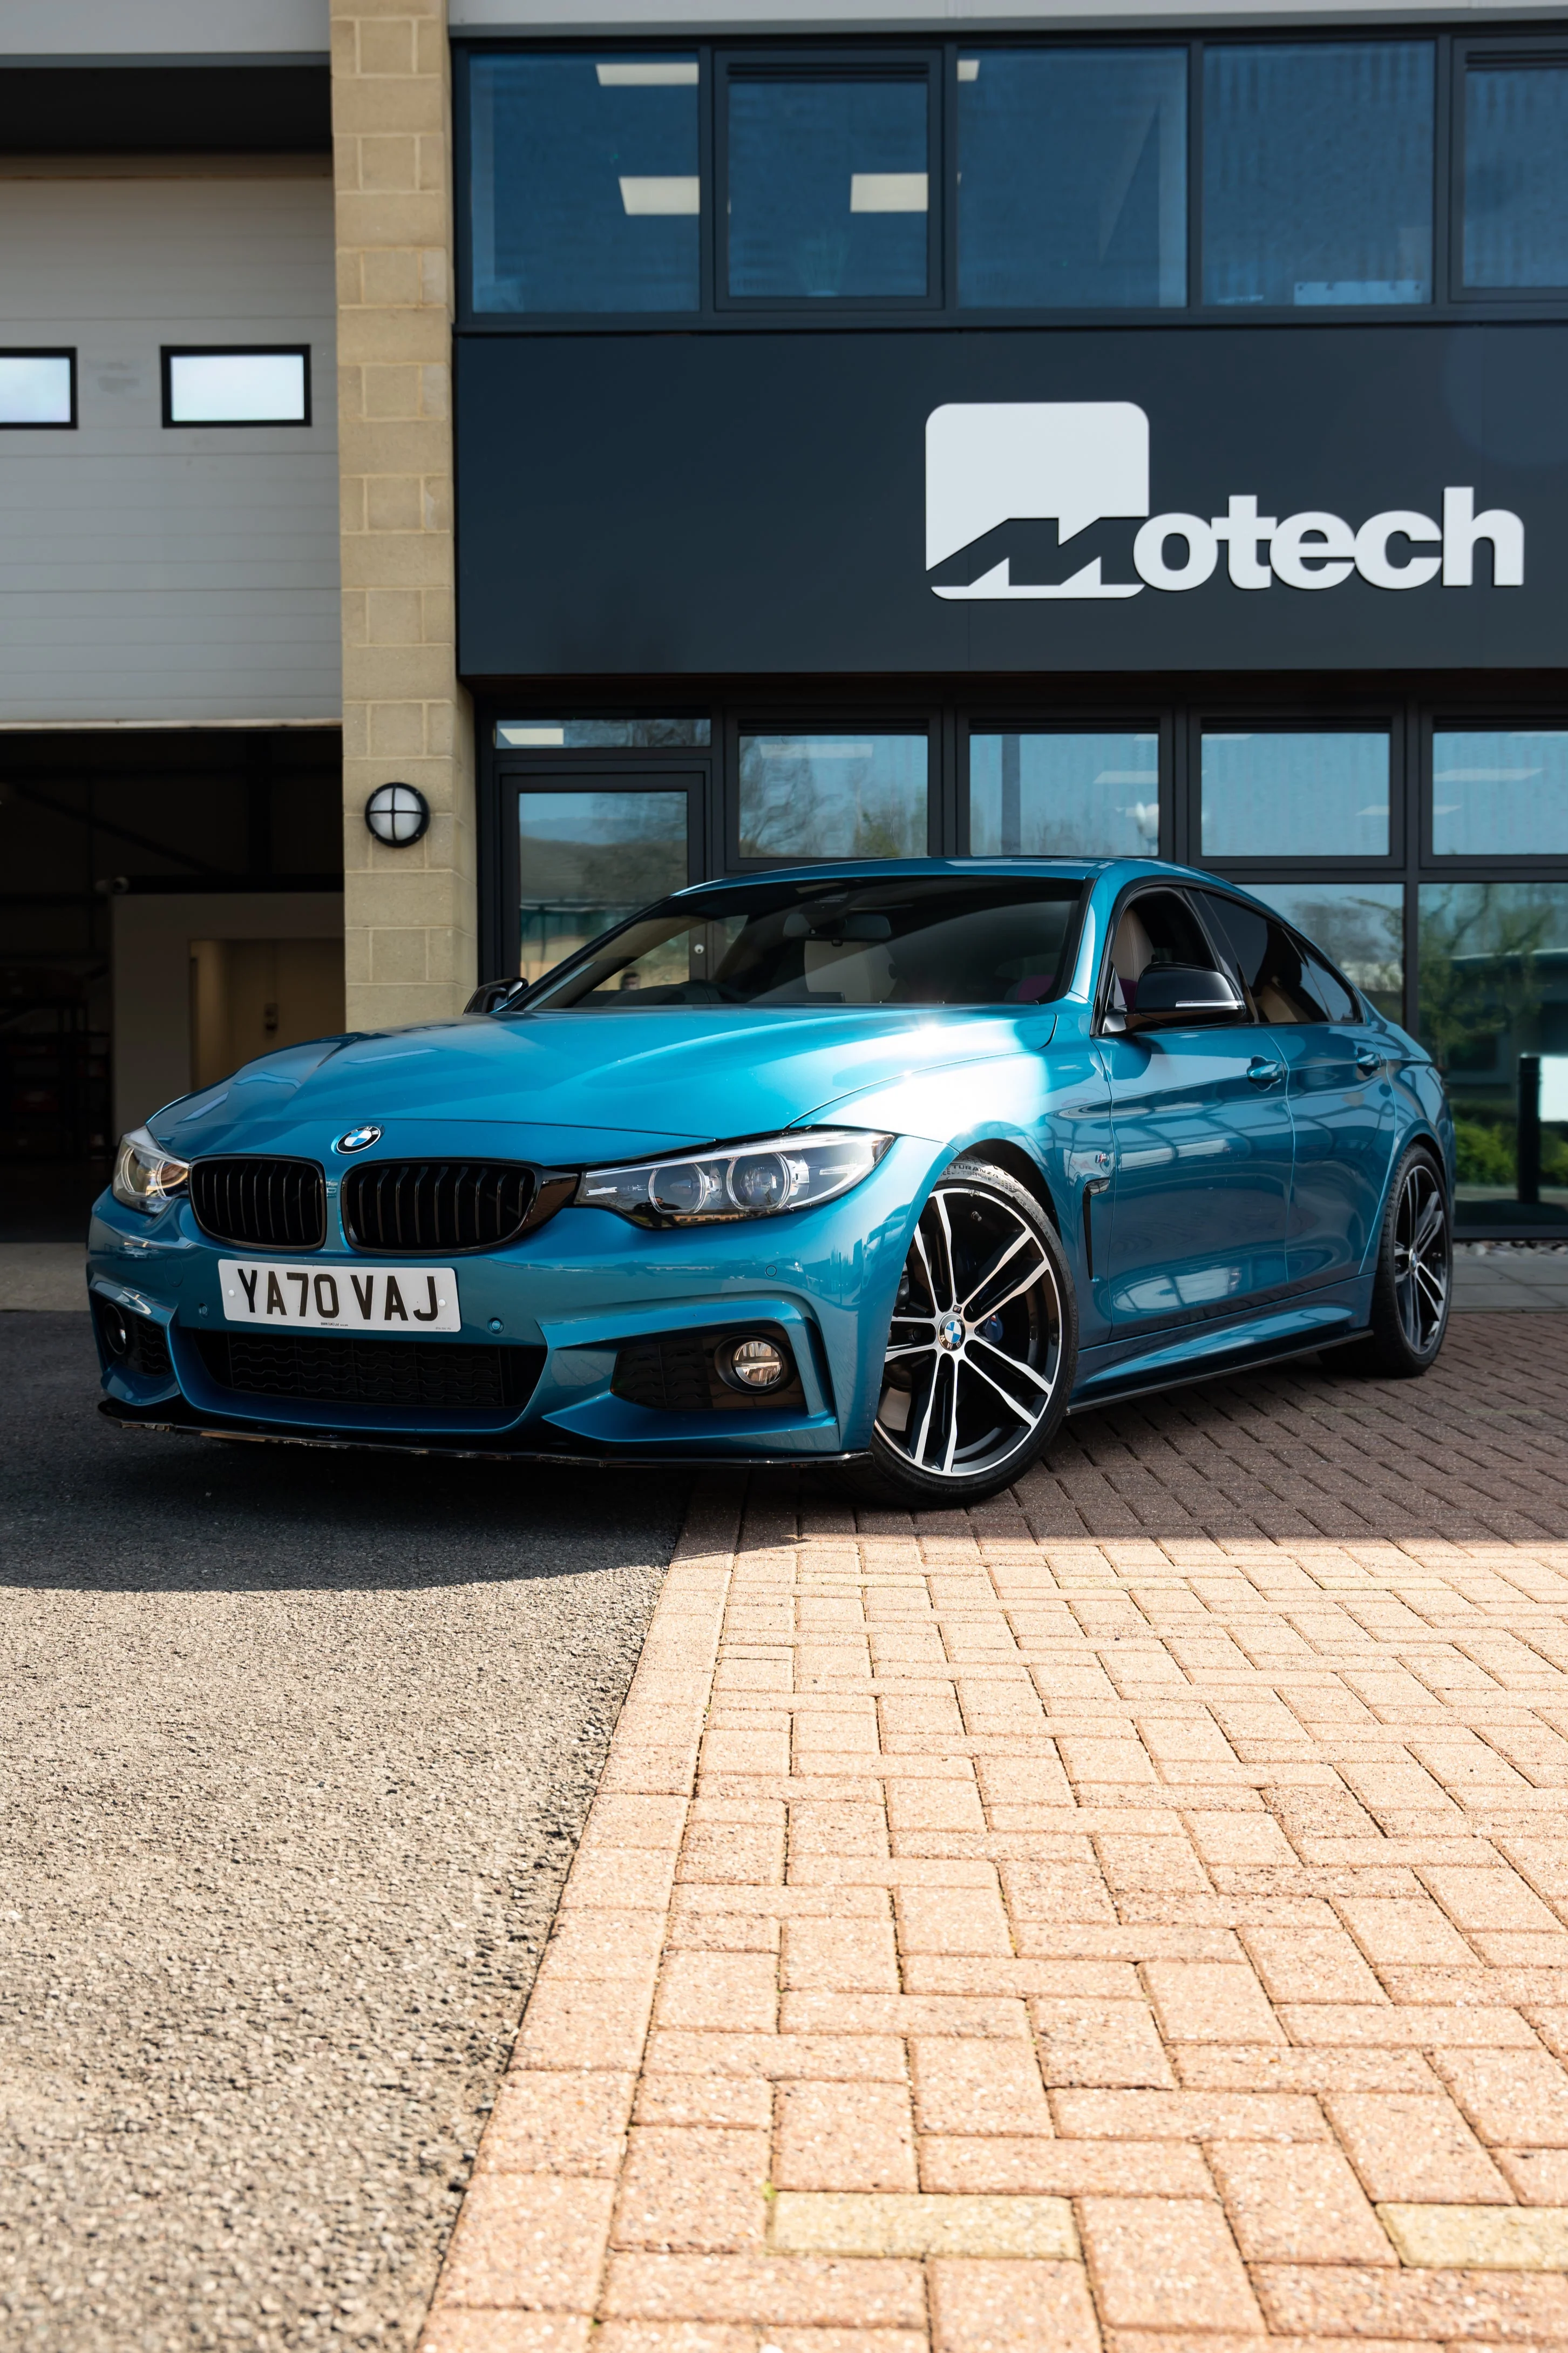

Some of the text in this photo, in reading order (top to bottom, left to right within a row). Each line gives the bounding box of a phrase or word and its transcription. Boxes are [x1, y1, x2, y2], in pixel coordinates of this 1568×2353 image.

[926, 486, 1524, 599] Motech
[953, 1164, 999, 1179] TURANZA
[237, 1268, 439, 1322] YA70 VAJ
[940, 1334, 961, 1350] BMW
